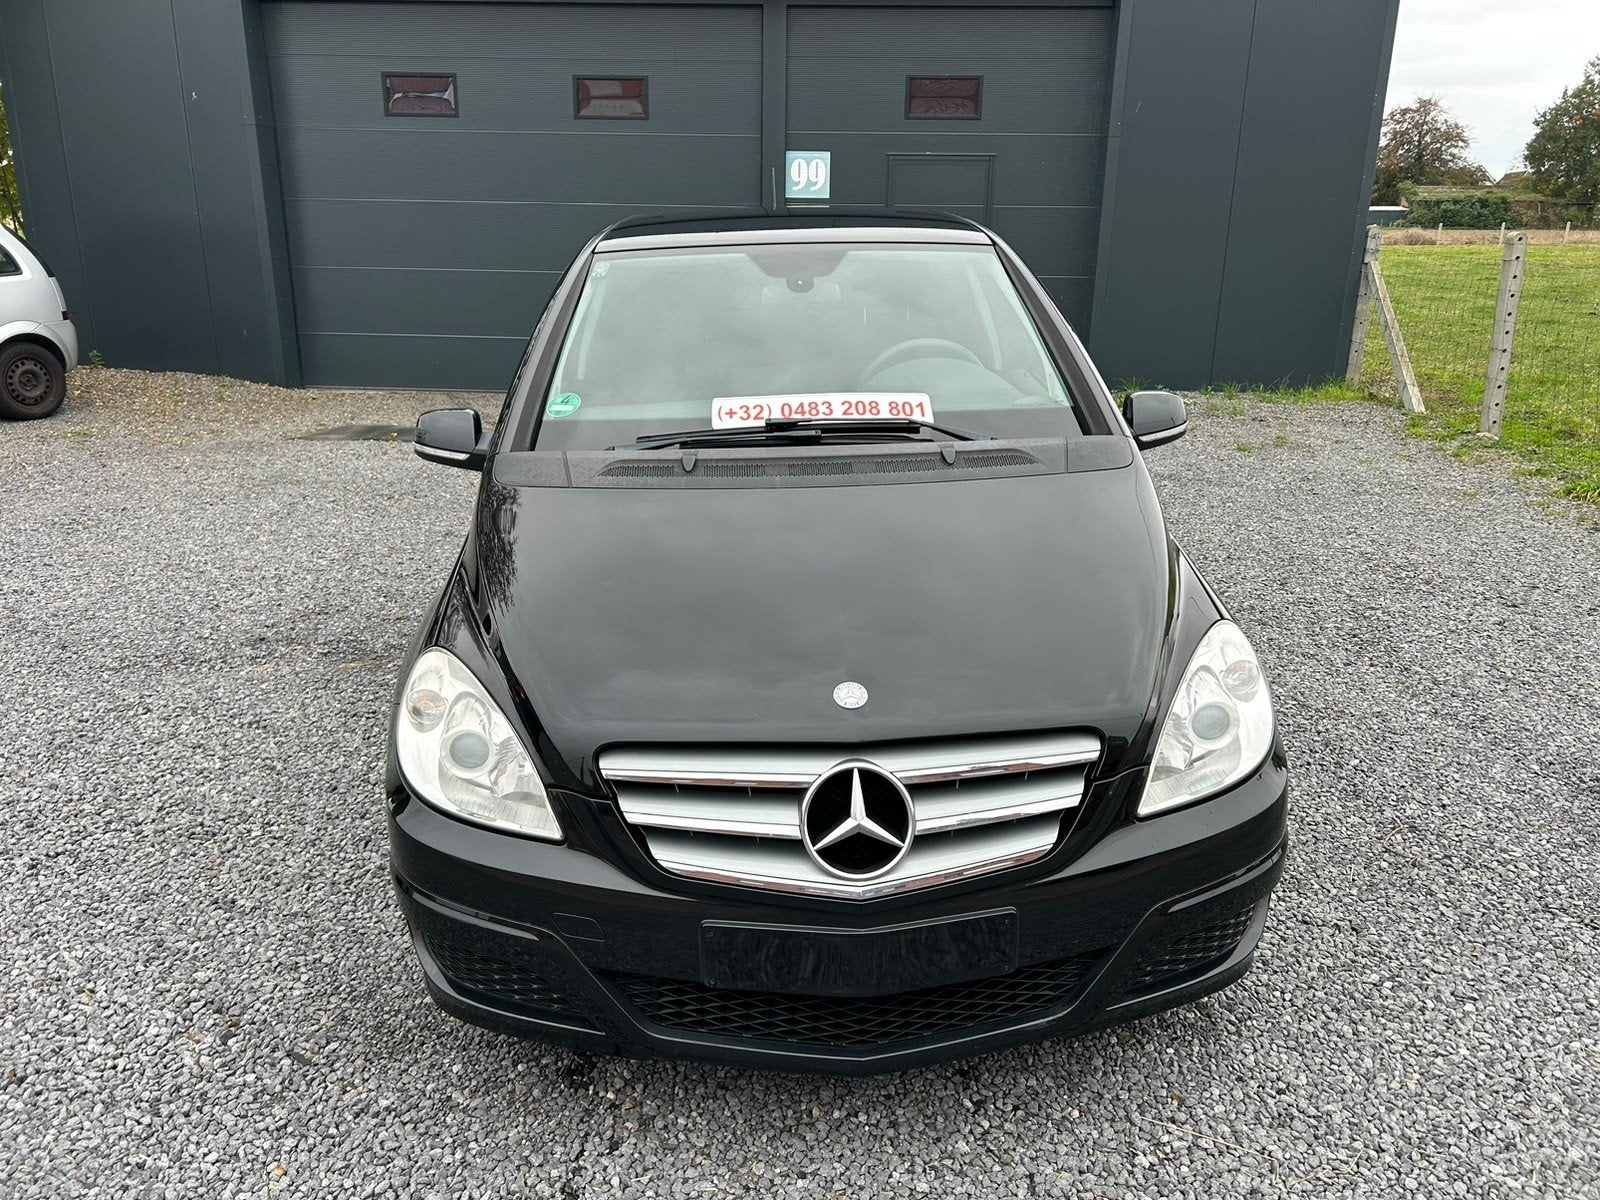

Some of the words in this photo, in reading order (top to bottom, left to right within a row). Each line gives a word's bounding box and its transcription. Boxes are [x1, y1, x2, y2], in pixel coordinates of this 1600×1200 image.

[790, 158, 826, 191] 99
[560, 394, 572, 406] 4
[717, 403, 772, 422] (+32)
[780, 400, 834, 419] 0483
[841, 400, 881, 417] 208
[888, 400, 926, 418] 801
